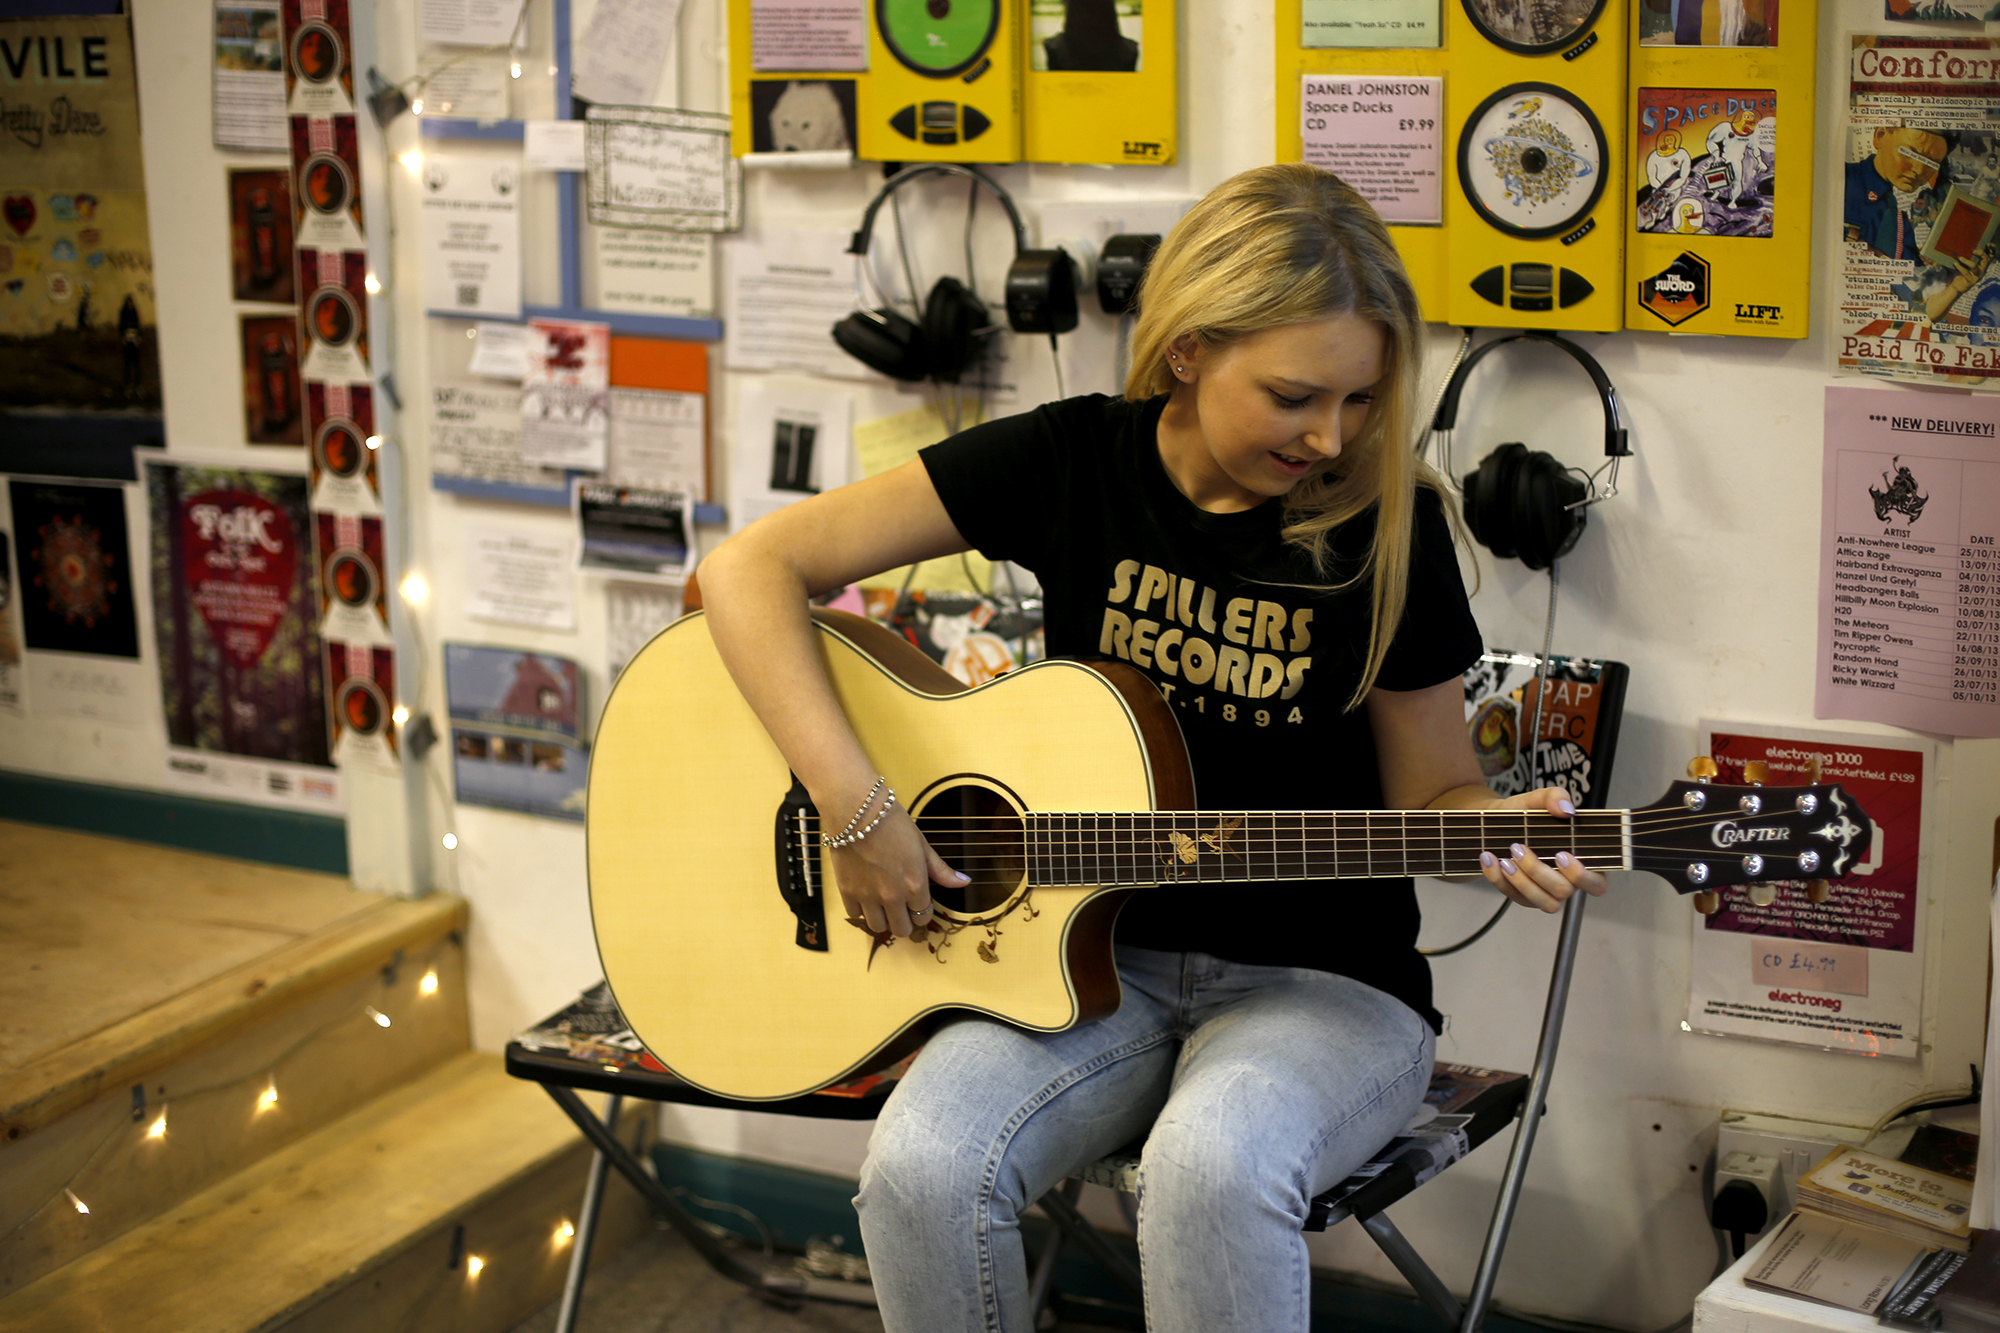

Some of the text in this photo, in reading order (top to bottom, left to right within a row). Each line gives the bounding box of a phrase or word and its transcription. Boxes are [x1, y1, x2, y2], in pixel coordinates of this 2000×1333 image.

[1568, 38, 1592, 58] START
[0, 36, 109, 78] VILE
[1306, 84, 1429, 96] DANIEL JOHNSTON
[1855, 83, 2000, 95] The critically acclaime
[1872, 94, 1917, 104] musically
[1921, 97, 1983, 106] kaleidoscopic
[1306, 101, 1393, 115] Space Ducks
[0, 97, 44, 149] retty
[1306, 119, 1435, 131] CD £9.99
[1942, 121, 1952, 130] by
[1124, 142, 1161, 155] LIFT
[1567, 224, 1590, 242] START
[1858, 258, 1912, 267] masterpiece"
[1655, 280, 1696, 292] SWORD
[1848, 293, 1898, 301] "excellent"
[1735, 304, 1780, 319] LIFT
[1846, 310, 1926, 322] "bloody brilliant"
[1842, 336, 1902, 360] Paid
[1914, 341, 1946, 364] To
[1891, 416, 1995, 435] NEW DELIVERY!
[1884, 528, 1911, 538] ARTIST
[1837, 536, 1936, 553] Anti-Nowhere League
[1970, 536, 1994, 545] DATE
[1837, 548, 1891, 561] Attica Rage
[1836, 560, 1942, 578] Hairband Extravaganza
[1836, 571, 1917, 587] Hanzel Und Gretyl
[1835, 583, 1919, 599] Headbangers Balls
[1107, 559, 1314, 653] SPILLERS
[1835, 595, 1939, 614] Hillbilly Moon Explosion
[1959, 596, 2000, 607] 12/07/13
[1958, 608, 2000, 619] 10/08/13
[1834, 618, 1889, 630] The Meteors
[1956, 620, 2000, 631] 03/07/13
[1834, 629, 1913, 646] Tim Ripper Owens
[1956, 632, 1999, 643] 22/11/13
[1099, 607, 1312, 700] RECORDS
[1833, 641, 1881, 653] Psycroptic
[1956, 644, 1999, 655] 16/08/13
[1833, 653, 1899, 667] Random Hand
[1955, 656, 1998, 667] 25/09/13
[1833, 665, 1899, 678] Ricky Warwick
[1954, 668, 1997, 679] 26/10/13
[1832, 676, 1895, 690] White Wizzard
[1953, 680, 1997, 690] 23/07/13
[1953, 692, 1996, 702] 05/10/13
[1835, 753, 1862, 765] 1000
[1768, 760, 1795, 771] welsh
[1889, 772, 1915, 783] £4.99
[1711, 820, 1790, 848] CRAFTER
[1773, 898, 1786, 906] The
[1786, 900, 1812, 909] Hidden
[1763, 954, 1837, 972] CD £4.99
[1768, 989, 1842, 1013] electroneg
[1447, 1065, 1492, 1077] BITE
[1845, 1158, 1943, 1191] More to
[1894, 1181, 1945, 1198] the Vale
